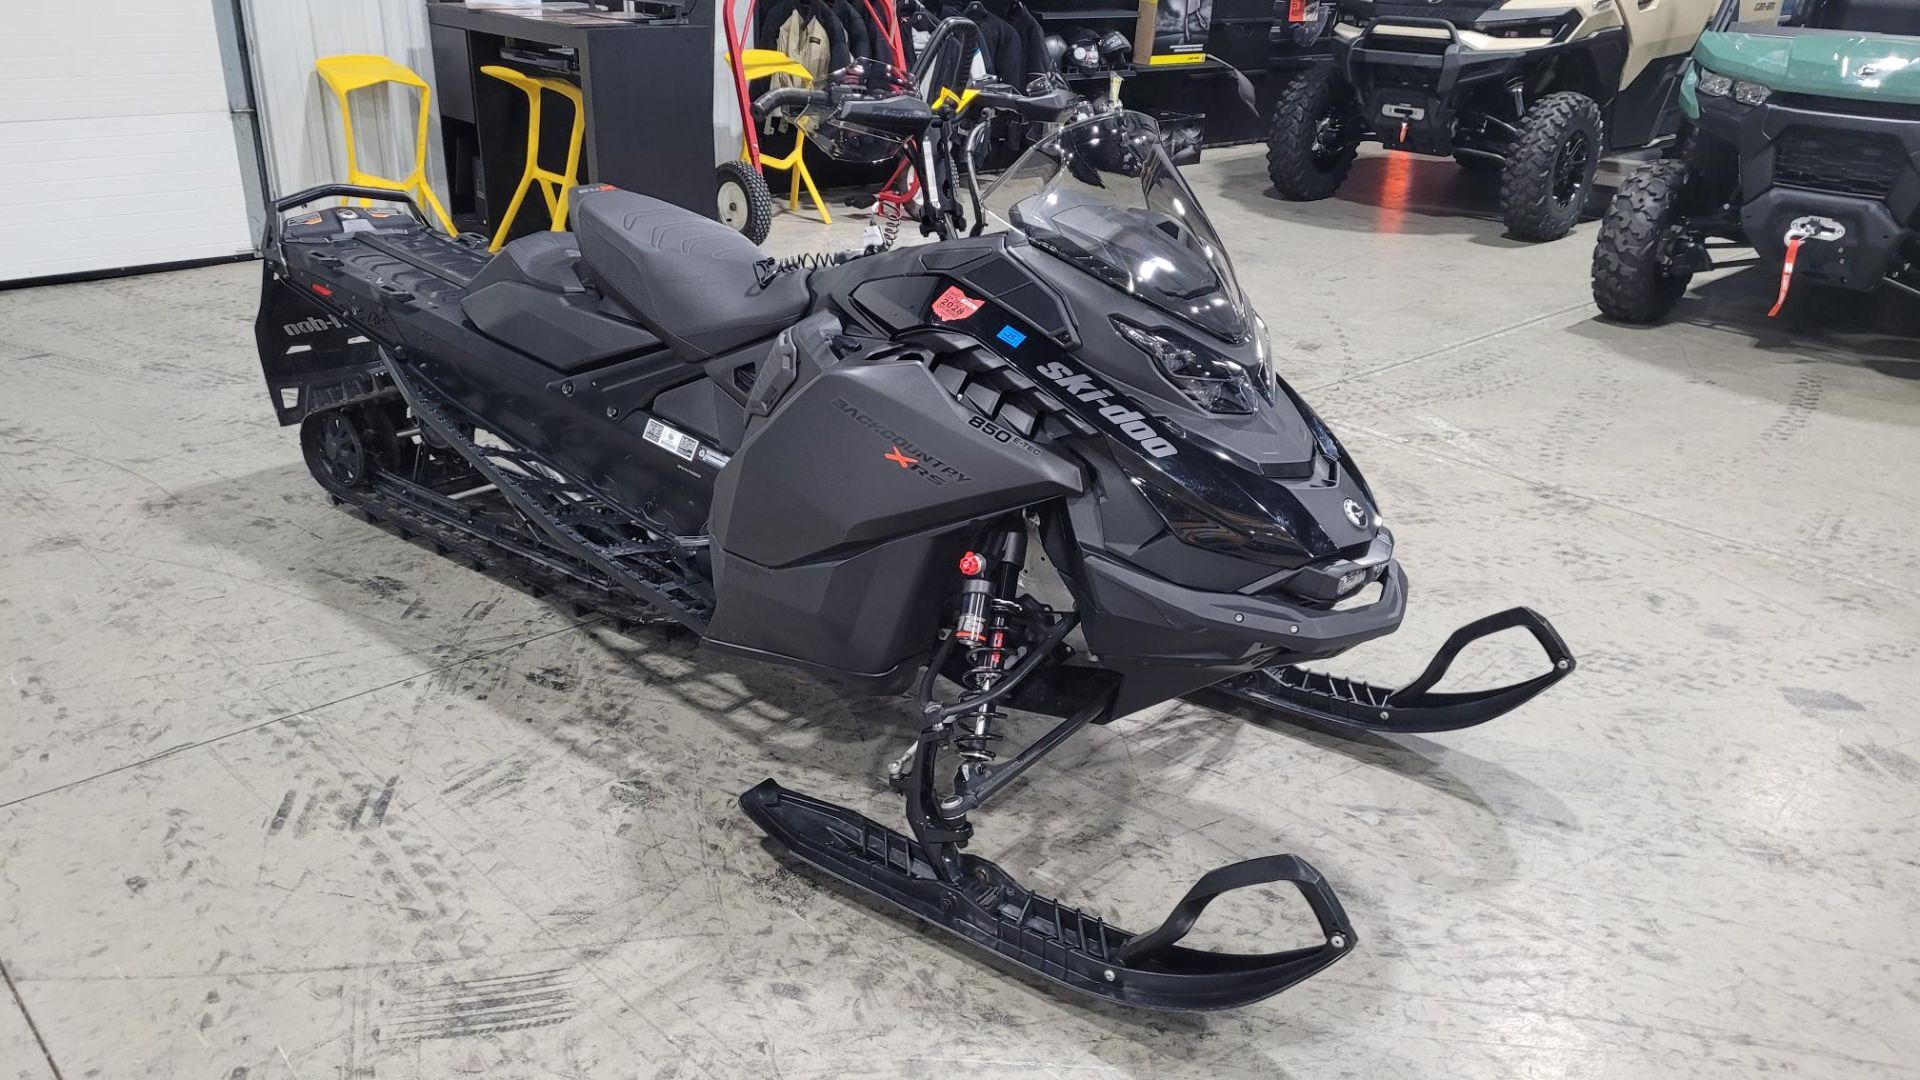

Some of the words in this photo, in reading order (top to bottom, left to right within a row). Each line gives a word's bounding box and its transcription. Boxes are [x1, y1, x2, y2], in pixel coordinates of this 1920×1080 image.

[940, 298, 964, 315] 2028
[831, 397, 972, 484] BACKCOUNTRY
[968, 415, 1012, 444] 850
[1012, 437, 1043, 456] E-TEC
[1036, 362, 1177, 458] ski-doo
